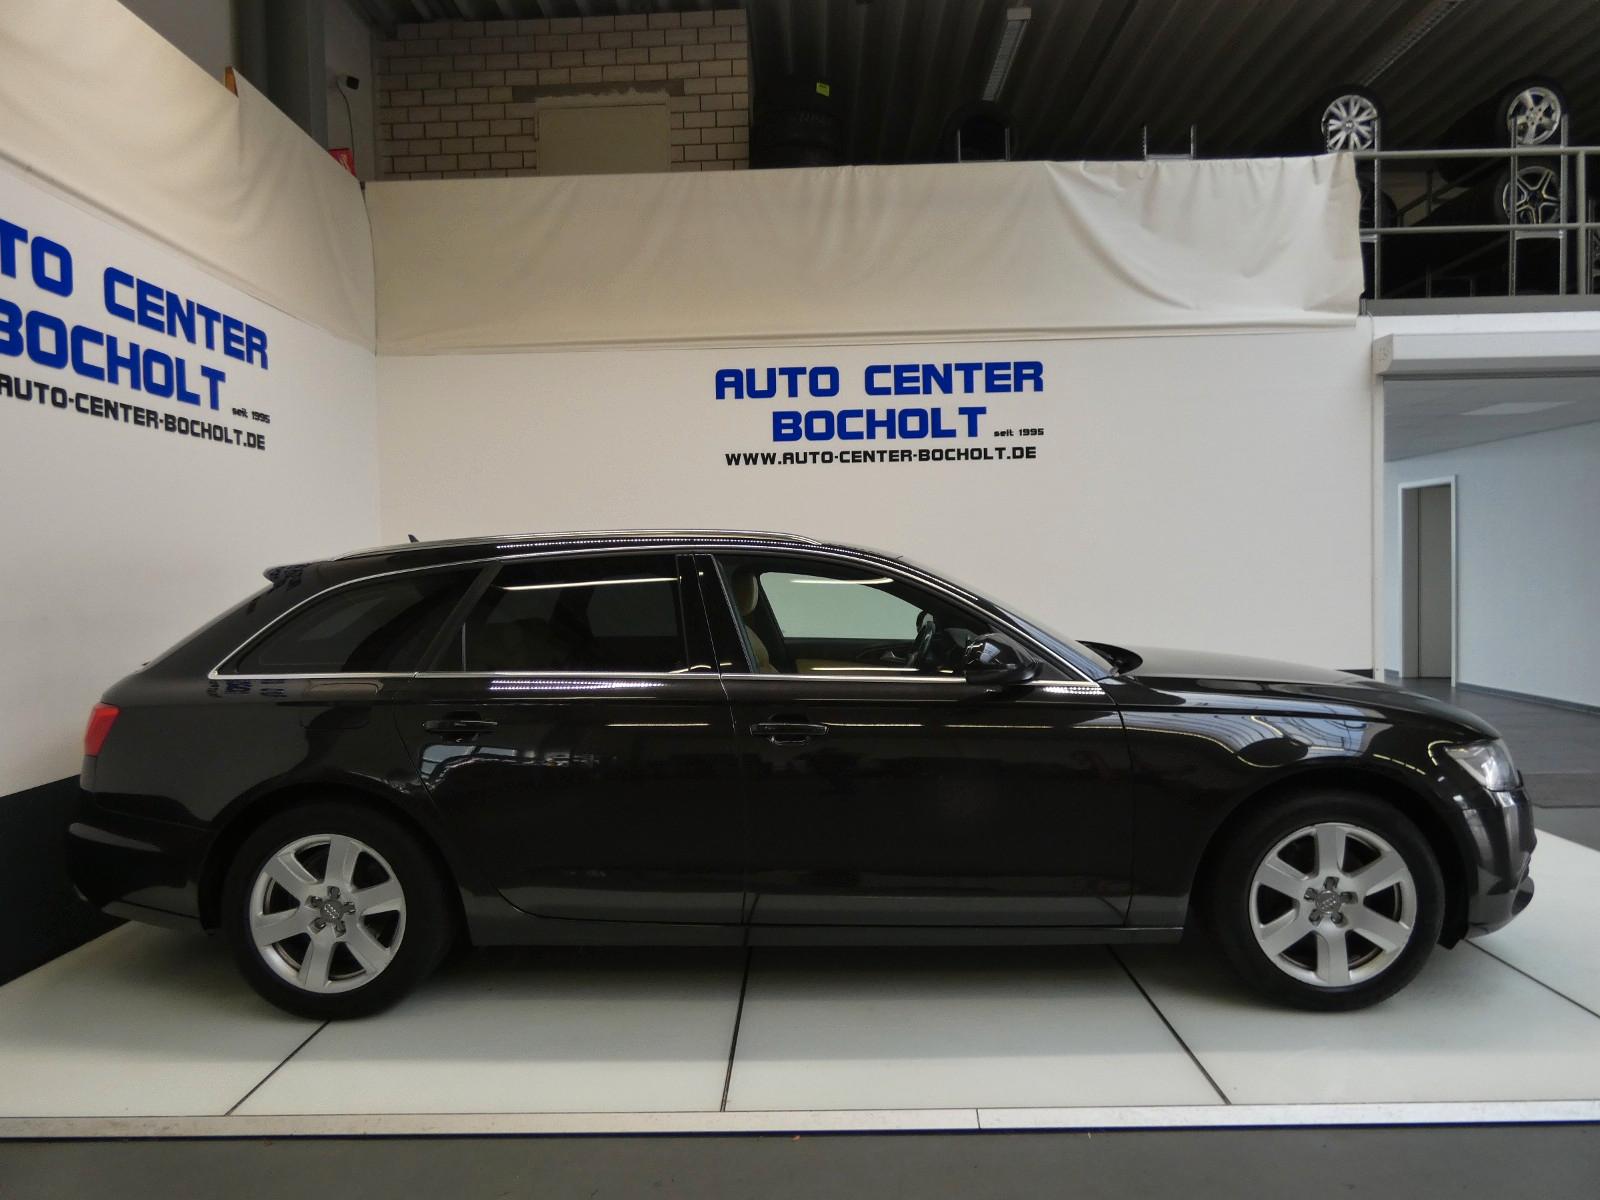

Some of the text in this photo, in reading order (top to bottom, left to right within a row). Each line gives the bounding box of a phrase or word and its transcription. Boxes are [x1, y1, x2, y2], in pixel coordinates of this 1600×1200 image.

[103, 266, 269, 370] CENTER
[0, 297, 226, 411] BOCHOLT
[715, 360, 1044, 400] AUTO CENTER
[772, 406, 1045, 442] BOCHOLT seit 1995
[725, 446, 1037, 466] WWW.AUTO-CENTER-BOCHOLT.DE
